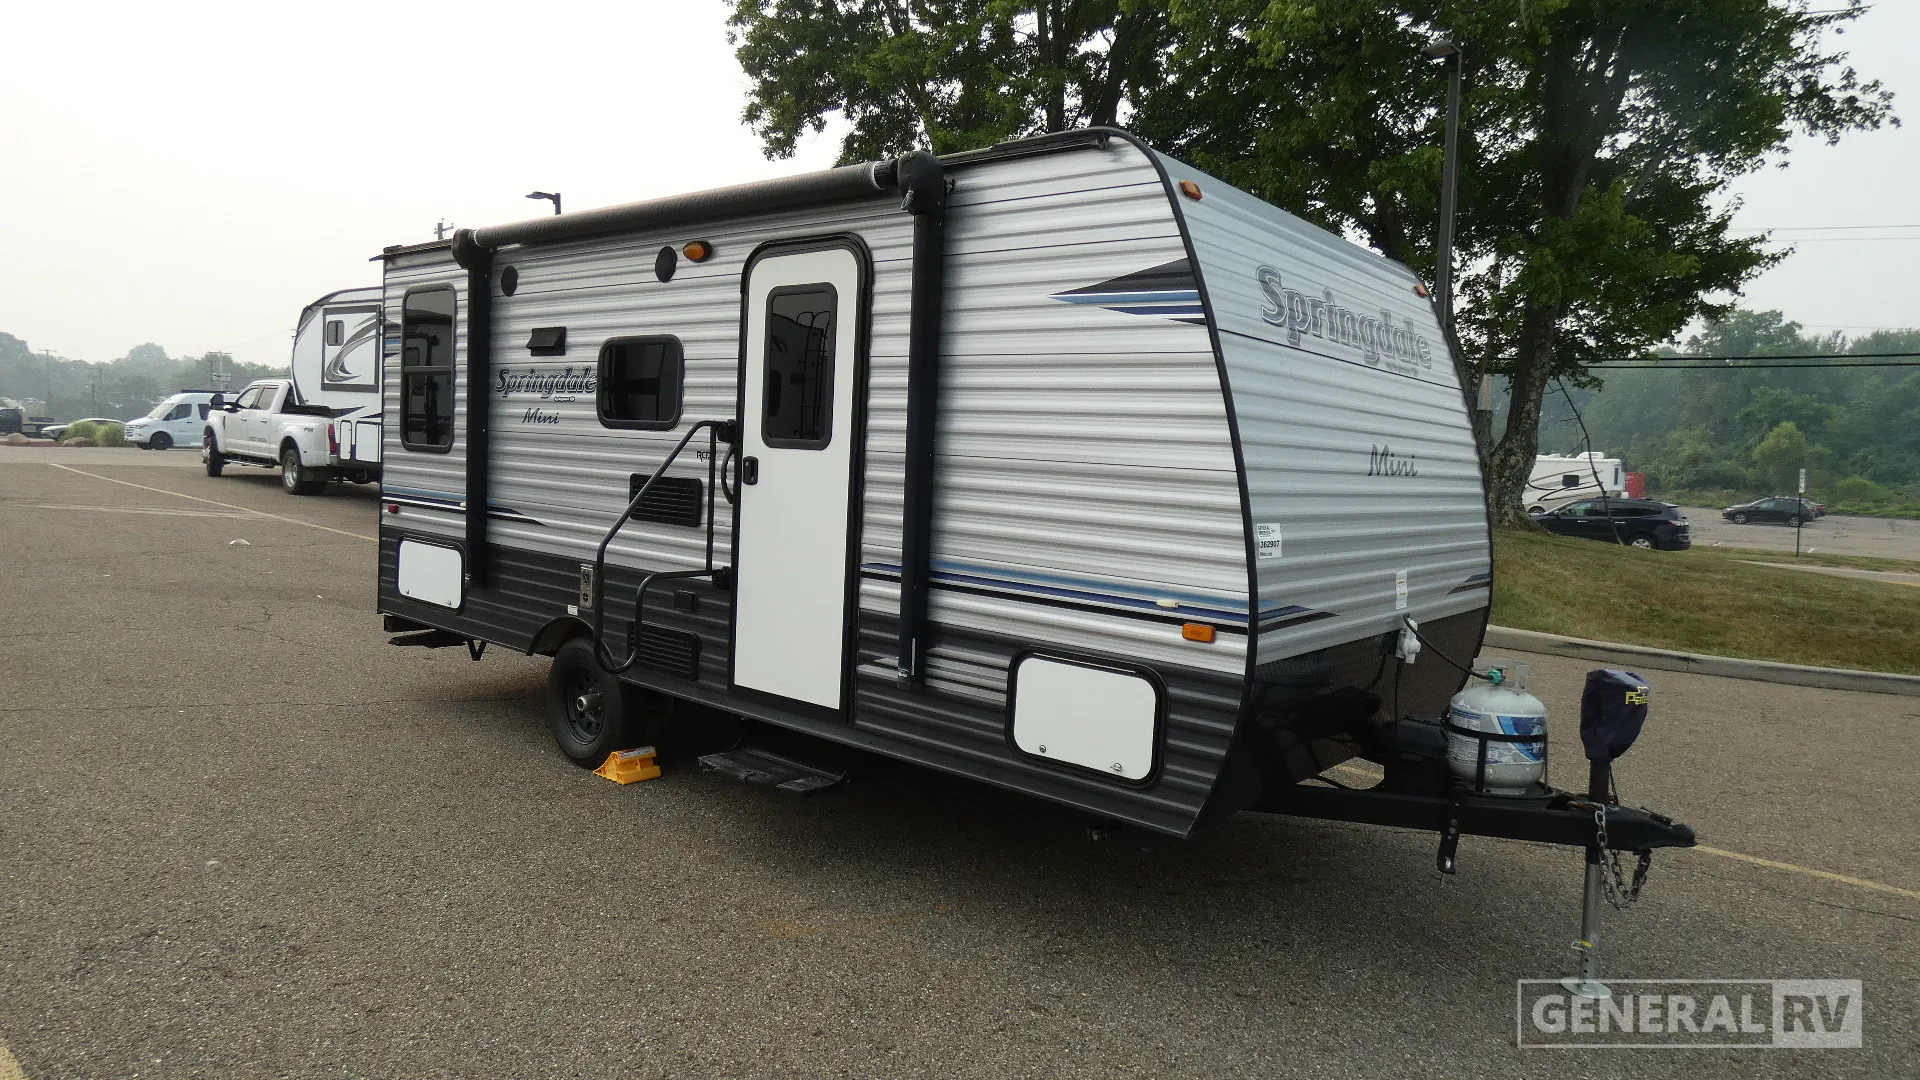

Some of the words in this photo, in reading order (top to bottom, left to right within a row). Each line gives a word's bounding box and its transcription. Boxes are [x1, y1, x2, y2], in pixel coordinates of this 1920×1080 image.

[1256, 265, 1432, 369] Springdale
[495, 366, 598, 398] Springdale
[521, 407, 560, 424] Mini
[1367, 443, 1418, 477] Mini
